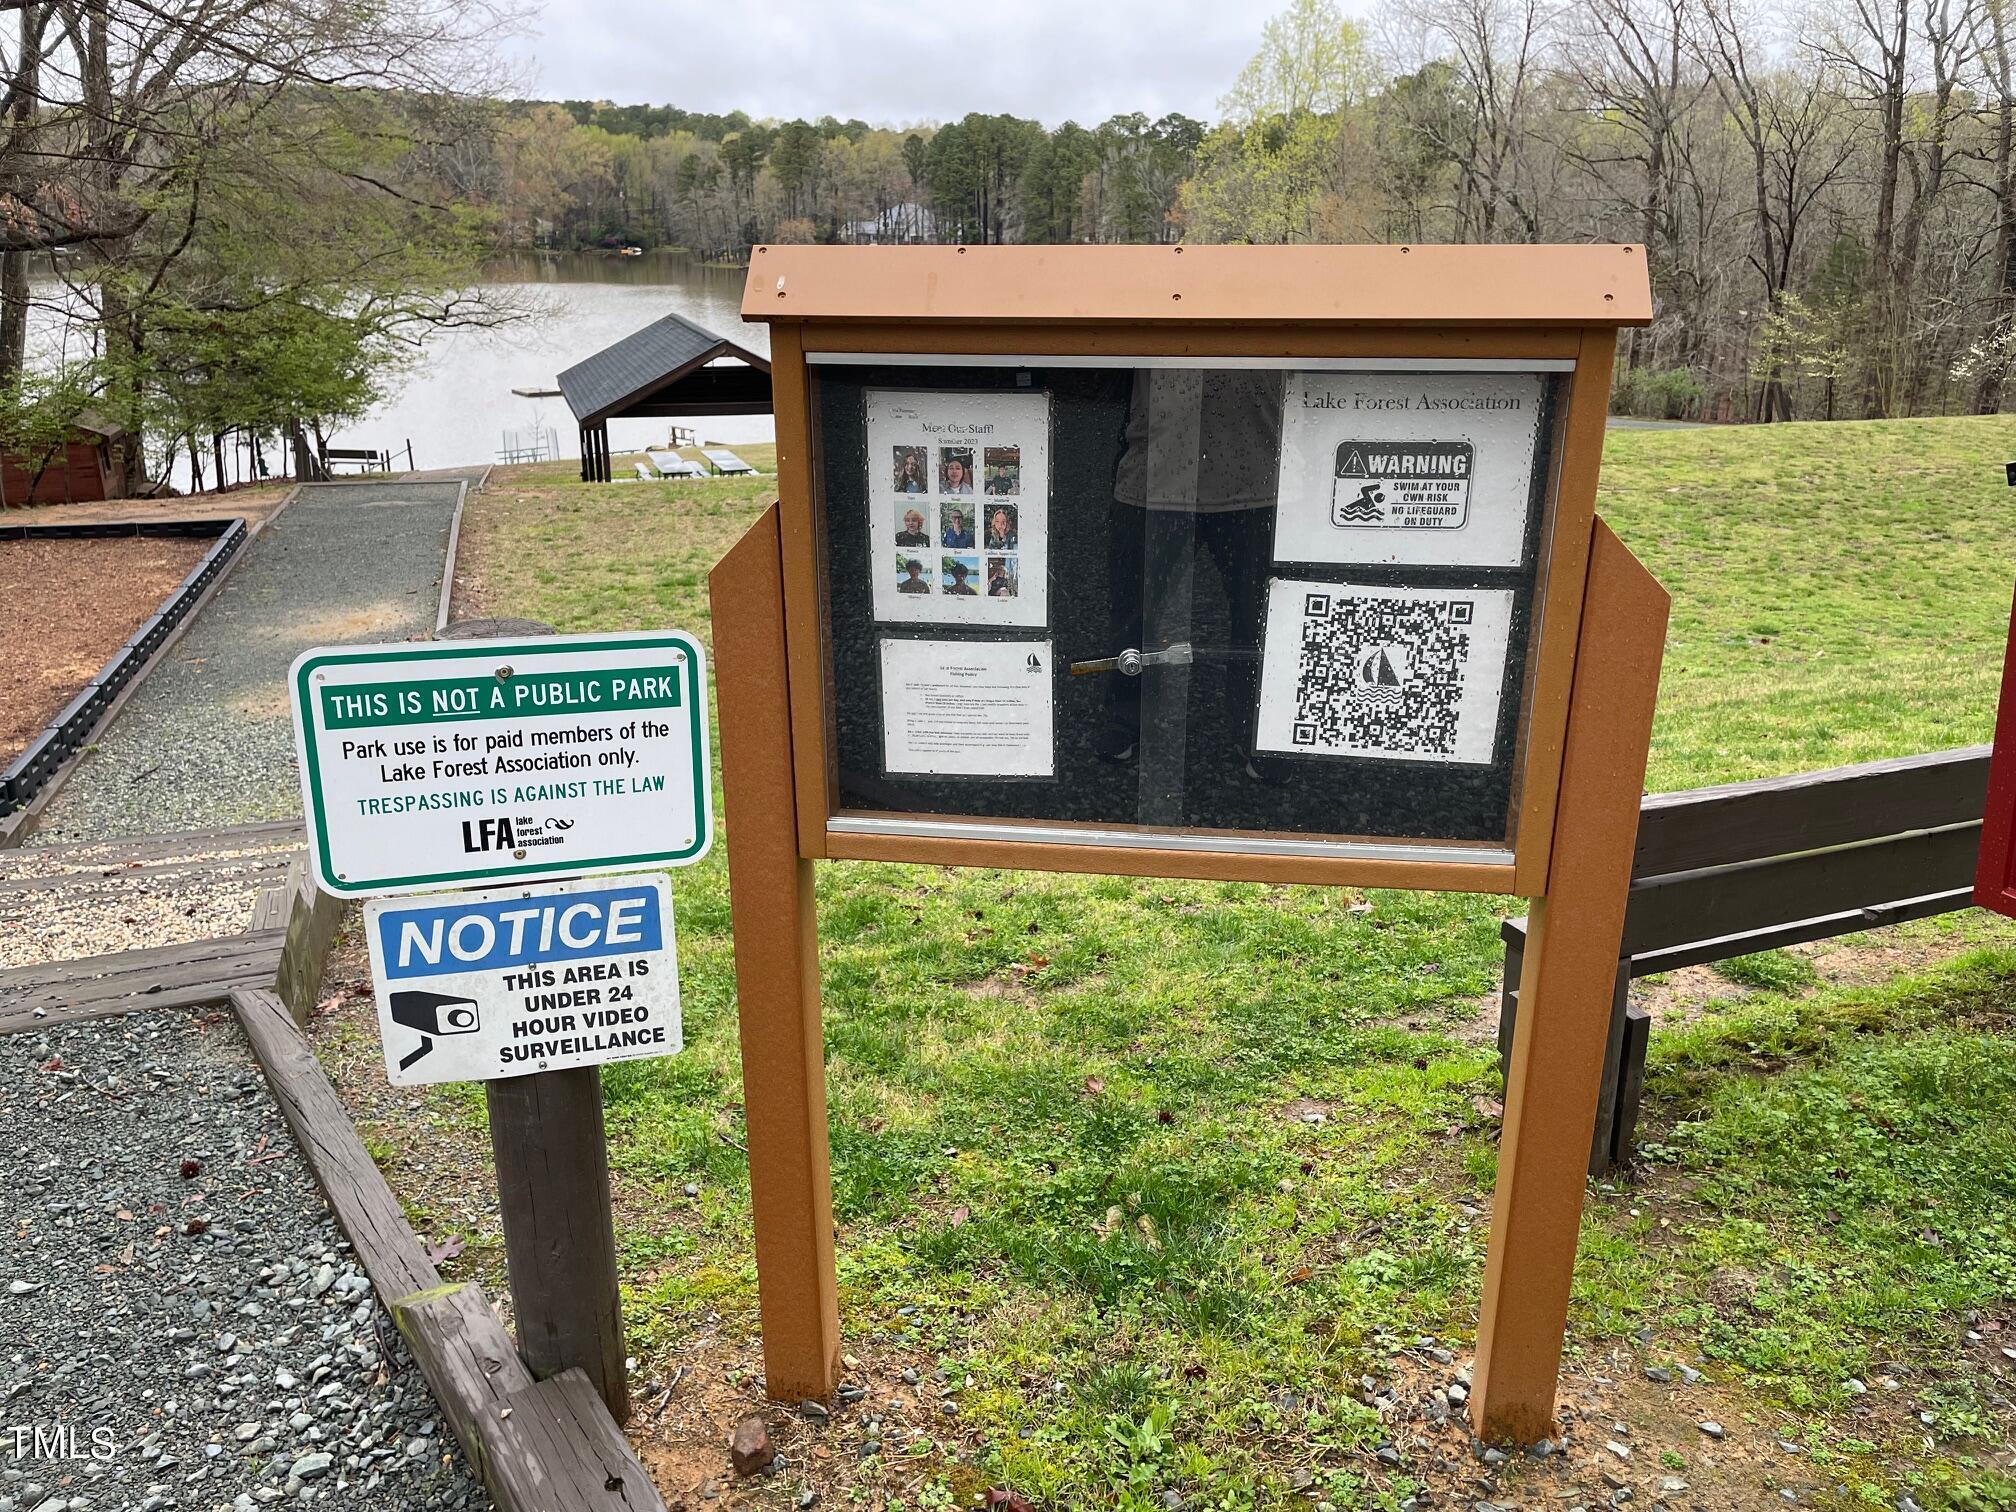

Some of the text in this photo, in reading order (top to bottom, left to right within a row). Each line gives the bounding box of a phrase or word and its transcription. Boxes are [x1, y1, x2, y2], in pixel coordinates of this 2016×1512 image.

[1303, 392, 1521, 410] Lake Forest Association
[1368, 454, 1467, 474] WARNING
[1393, 482, 1460, 491] SWIM AT YOUR
[1427, 493, 1448, 502] RISK
[1392, 506, 1457, 515] NO LIFEGUARD
[1404, 517, 1443, 526] ON DUTY
[331, 676, 673, 719] THIS IS NOT A PUBLIC PARK
[342, 721, 669, 760] Park use is for paid members of the
[381, 748, 639, 783] Lake Forest Association only.
[357, 776, 665, 816] TRESPASSING IS AGAINST THE LAW
[516, 816, 533, 825] lake
[517, 827, 543, 836] forest
[462, 817, 515, 853] LFA
[518, 836, 564, 847] association
[398, 898, 647, 968] NOTICE
[503, 959, 649, 991] THIS AREA IS
[524, 985, 633, 1013] UNDER 24
[512, 1006, 649, 1038] HOUR VIDEO
[500, 1027, 666, 1063] SURVEILLANCE
